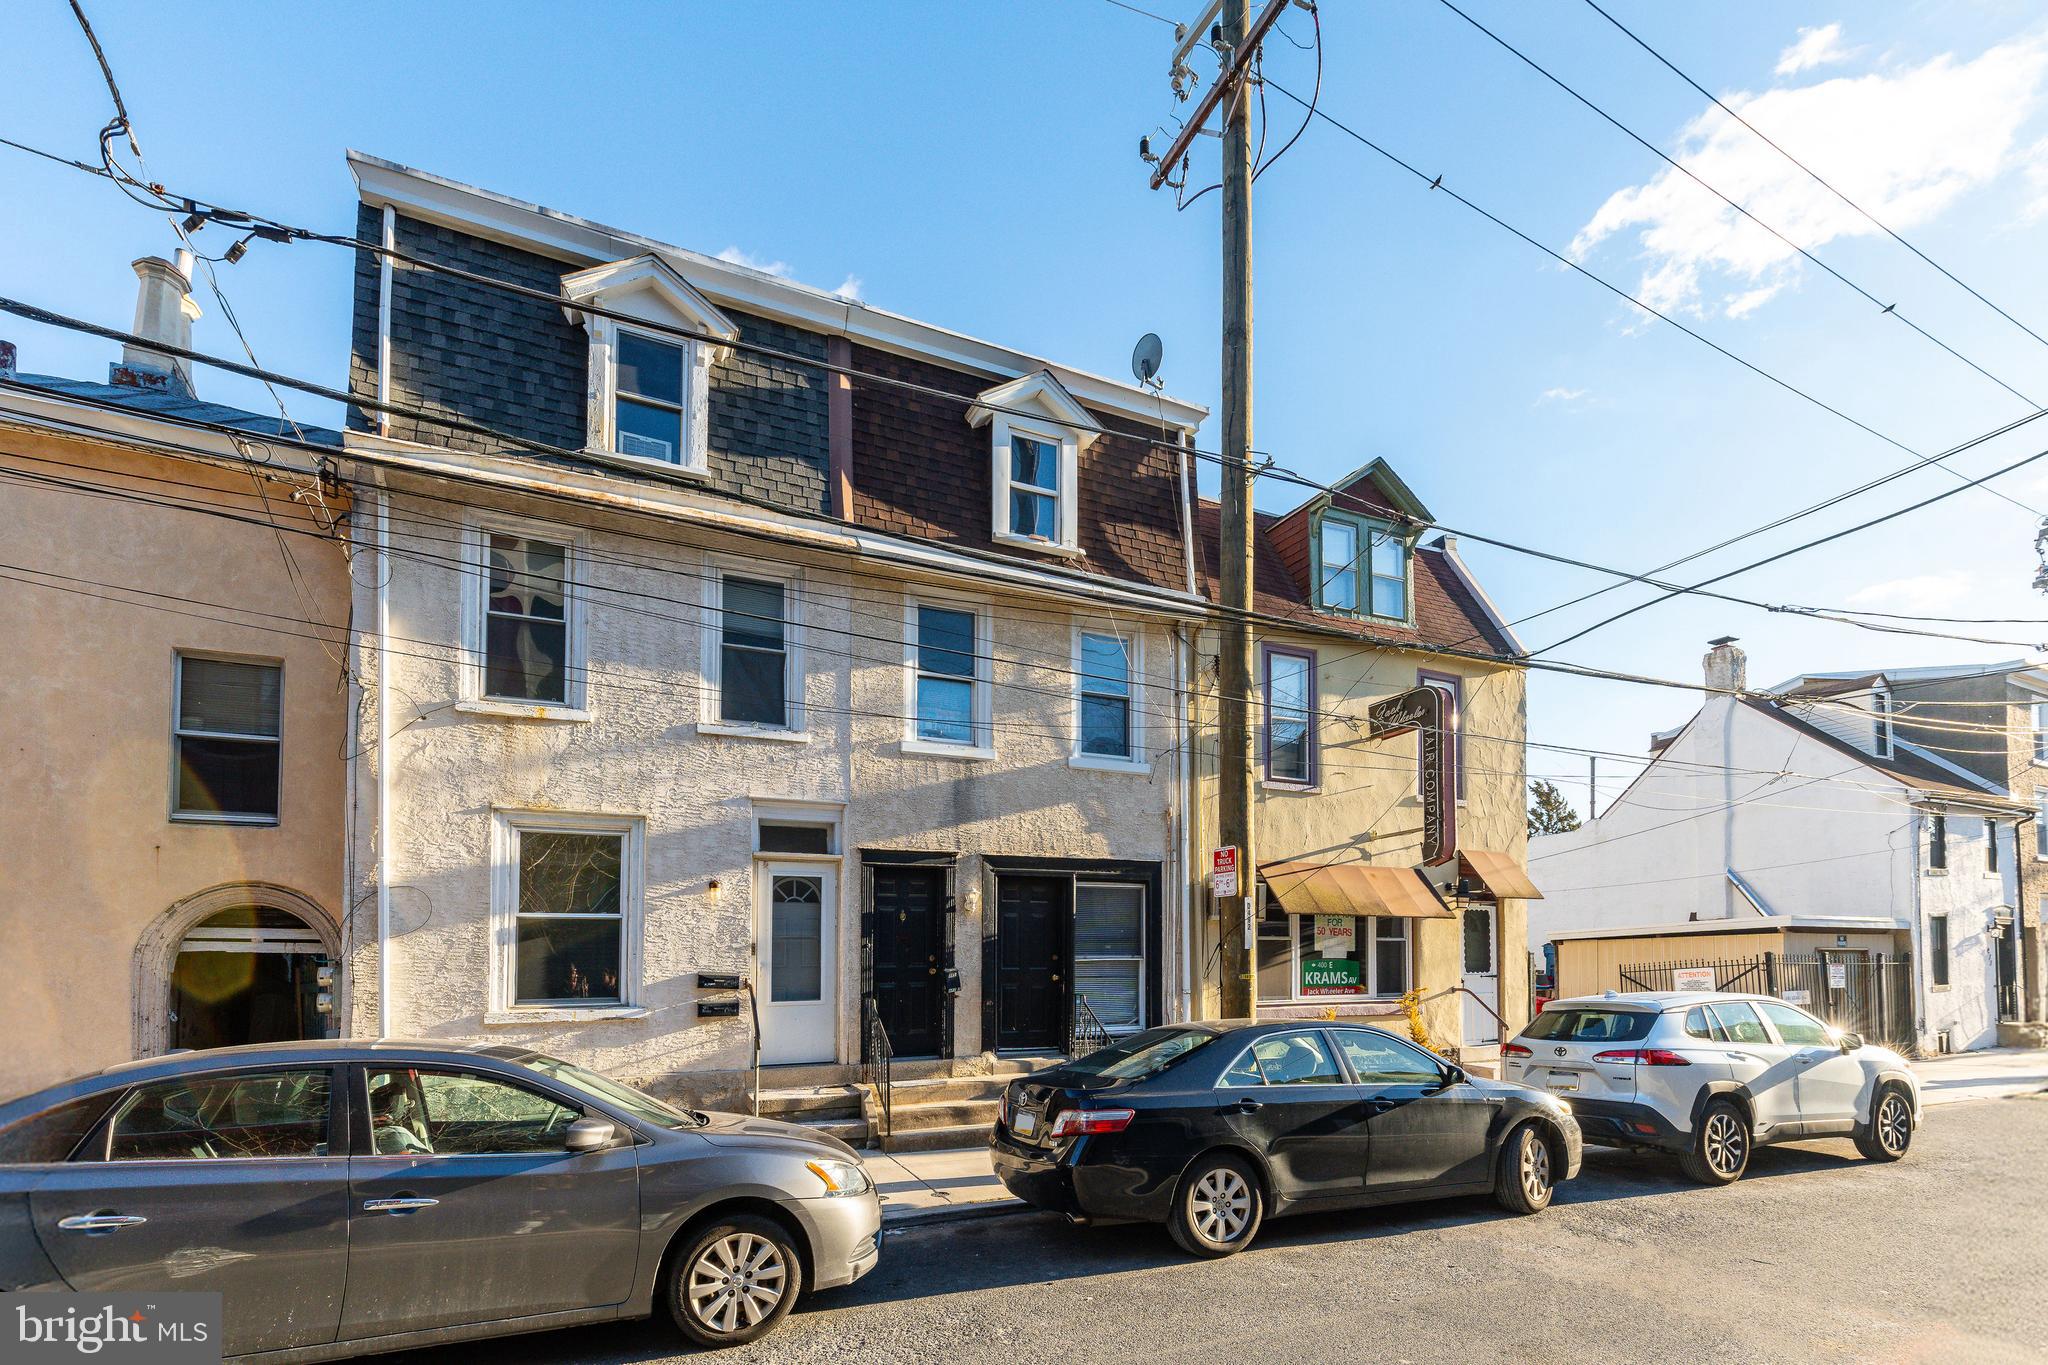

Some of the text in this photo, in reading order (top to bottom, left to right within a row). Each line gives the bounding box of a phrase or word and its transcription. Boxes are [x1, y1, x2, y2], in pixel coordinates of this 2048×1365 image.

[1375, 699, 1404, 723] Jack
[1425, 725, 1438, 846] HAIR COMPANY
[1220, 850, 1229, 858] NO
[1216, 858, 1232, 866] TRUCK
[1215, 865, 1234, 873] PARKING
[1327, 918, 1343, 926] FOR
[1317, 927, 1353, 937] 50 YEARS
[1317, 961, 1333, 969] 400 E
[1305, 971, 1348, 985] KRAMS
[1307, 988, 1320, 996] Jack
